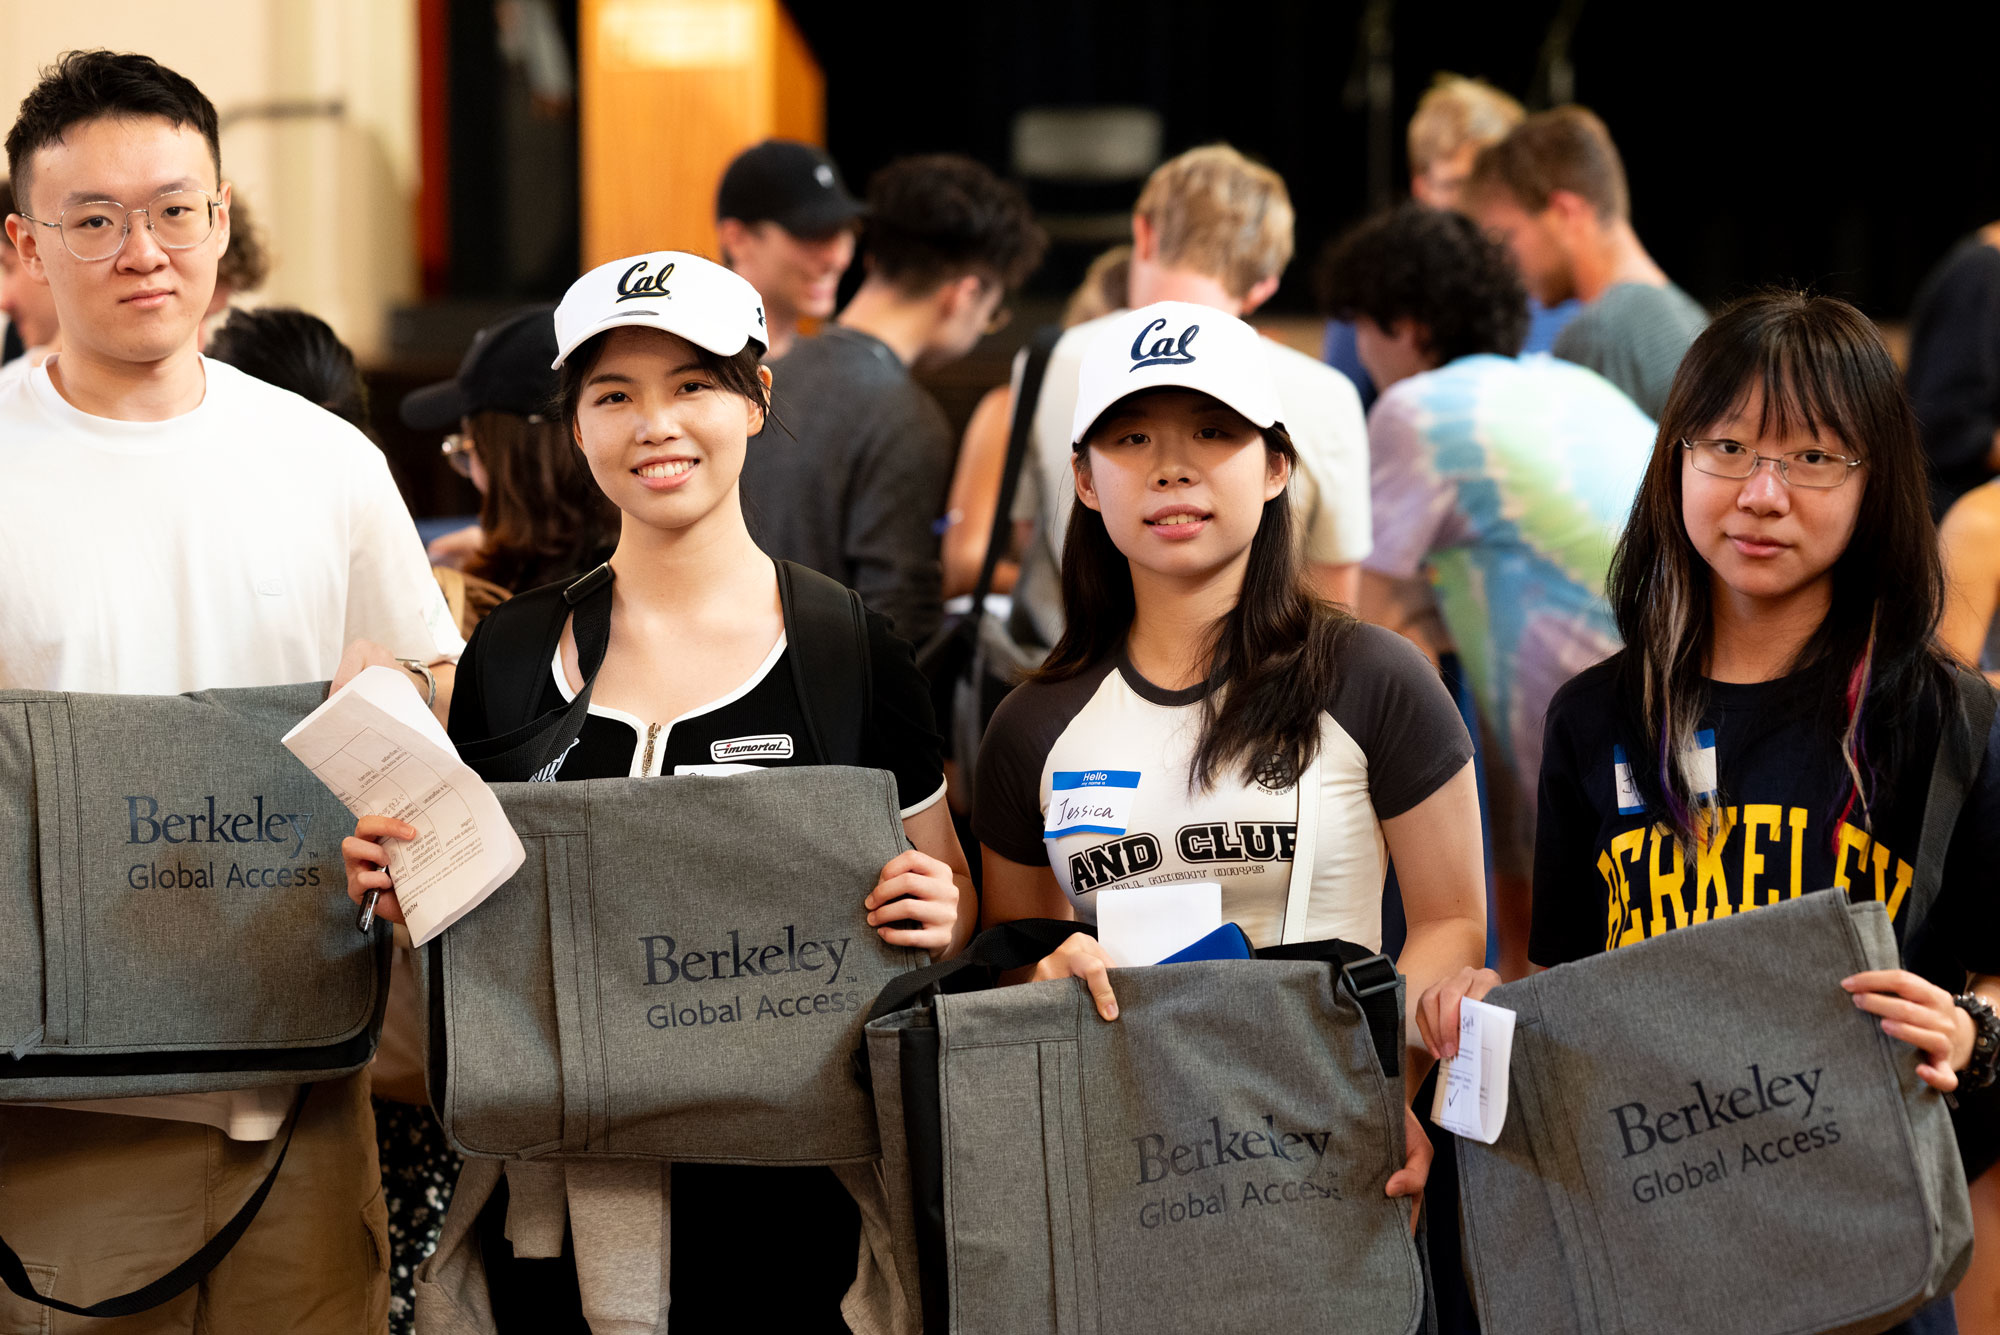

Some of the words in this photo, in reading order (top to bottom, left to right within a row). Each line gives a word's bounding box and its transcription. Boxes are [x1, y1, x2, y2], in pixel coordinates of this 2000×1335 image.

[615, 261, 674, 304] Cal
[1129, 317, 1199, 373] Cal
[723, 741, 783, 754] immortal
[1083, 772, 1108, 782] Hello
[122, 795, 314, 859] Berkeley
[1057, 797, 1115, 826] Jessica
[128, 862, 214, 889] Global
[226, 863, 321, 889] Access
[1068, 832, 1163, 896] AND
[638, 925, 851, 985] Berkeley
[647, 996, 742, 1029] Global
[756, 991, 860, 1020] Access
[1608, 1064, 1823, 1159] Berkeley
[1132, 1115, 1332, 1186] Berkeley
[1632, 1150, 1728, 1203] Global
[1742, 1121, 1841, 1172] Access
[1139, 1184, 1227, 1229] Global
